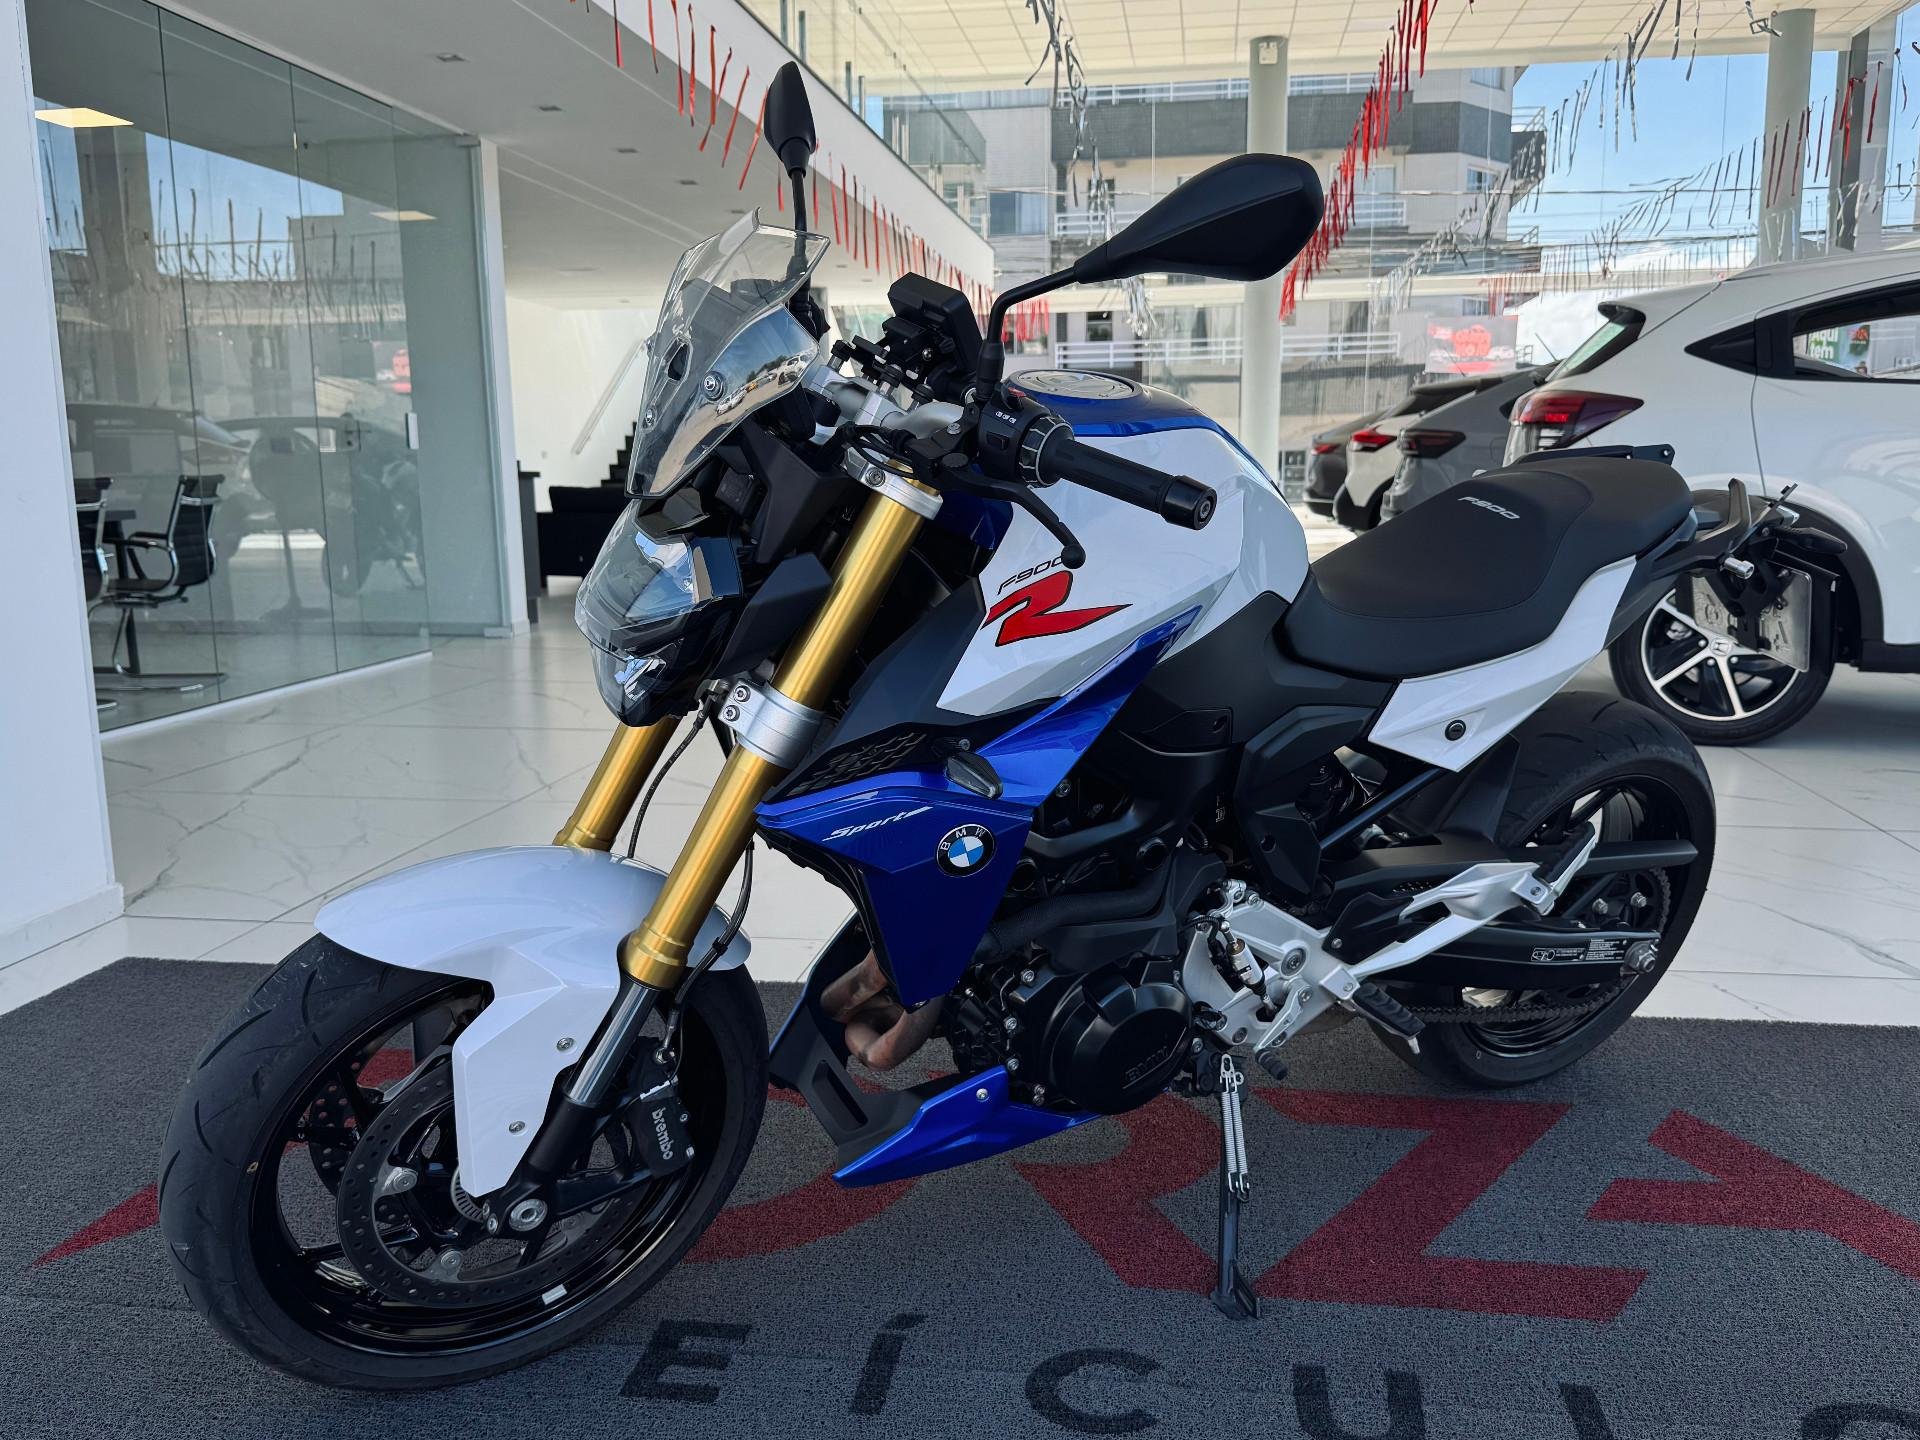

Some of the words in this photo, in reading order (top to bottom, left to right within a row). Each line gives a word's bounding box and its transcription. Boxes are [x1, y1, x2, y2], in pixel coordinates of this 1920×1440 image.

[822, 806, 934, 842] Sport
[939, 826, 986, 851] BMW
[651, 1106, 675, 1161] brembo
